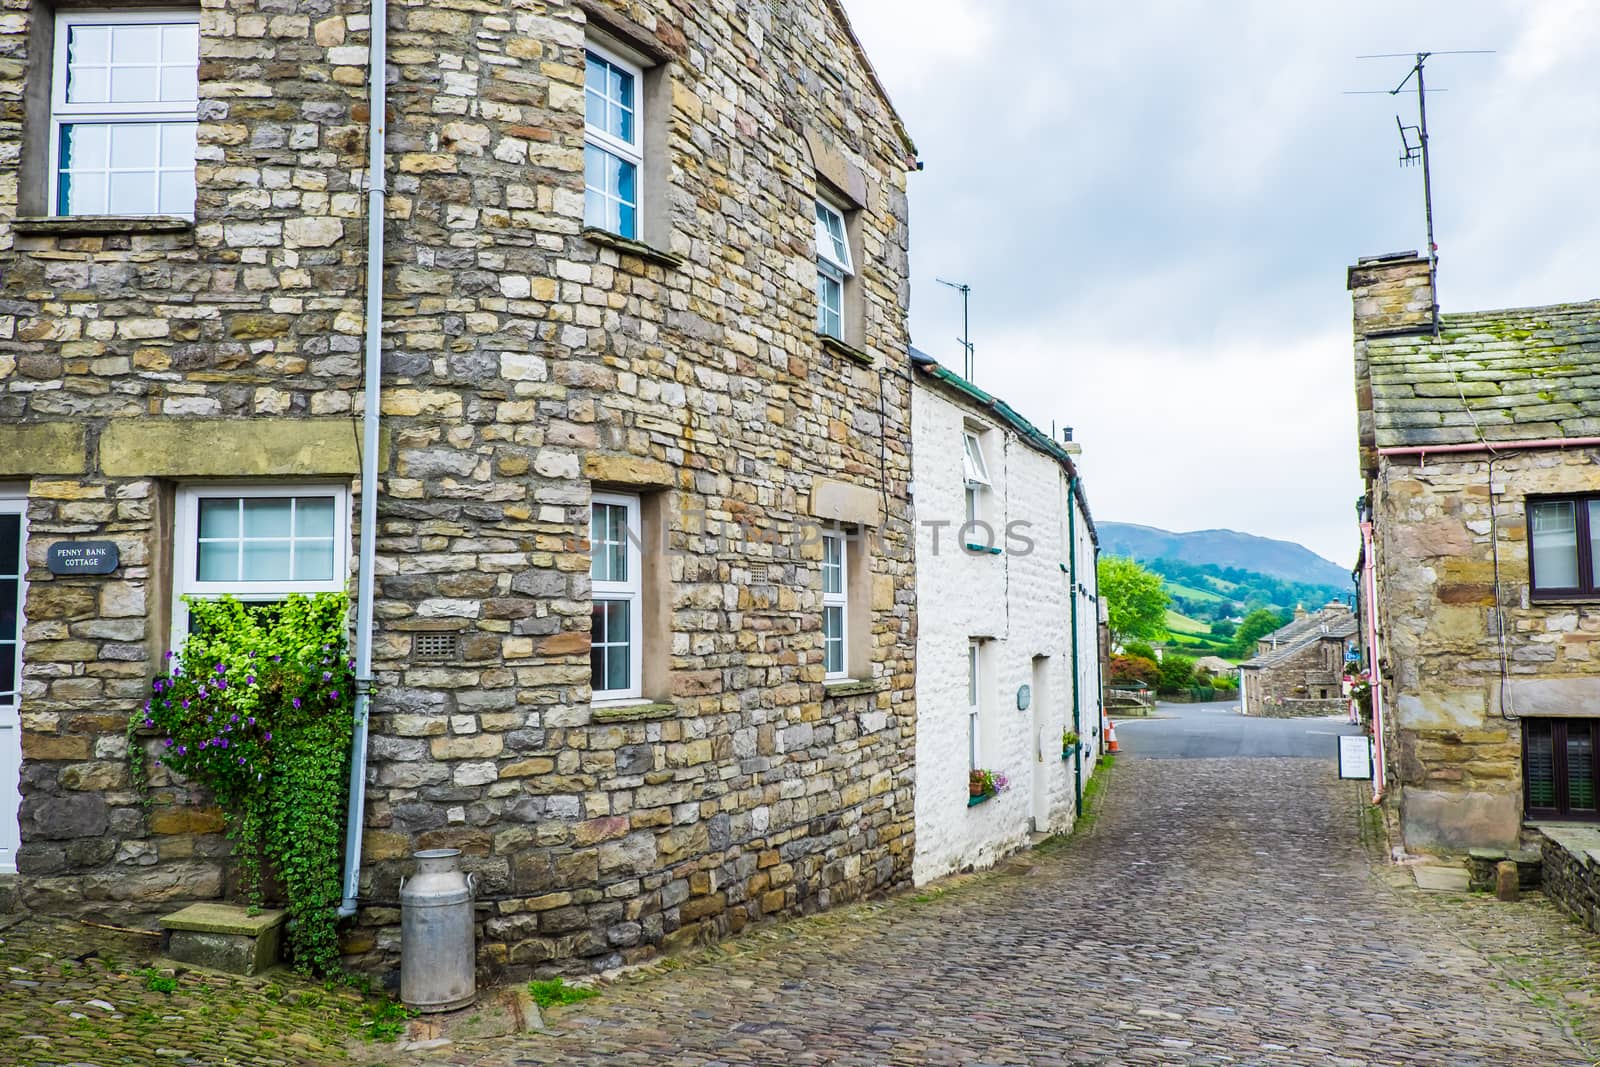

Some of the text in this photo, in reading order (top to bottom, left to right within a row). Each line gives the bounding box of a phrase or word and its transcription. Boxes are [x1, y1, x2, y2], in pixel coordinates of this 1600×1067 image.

[57, 548, 106, 557] PENNY BANK
[65, 558, 98, 566] COTTAGE
